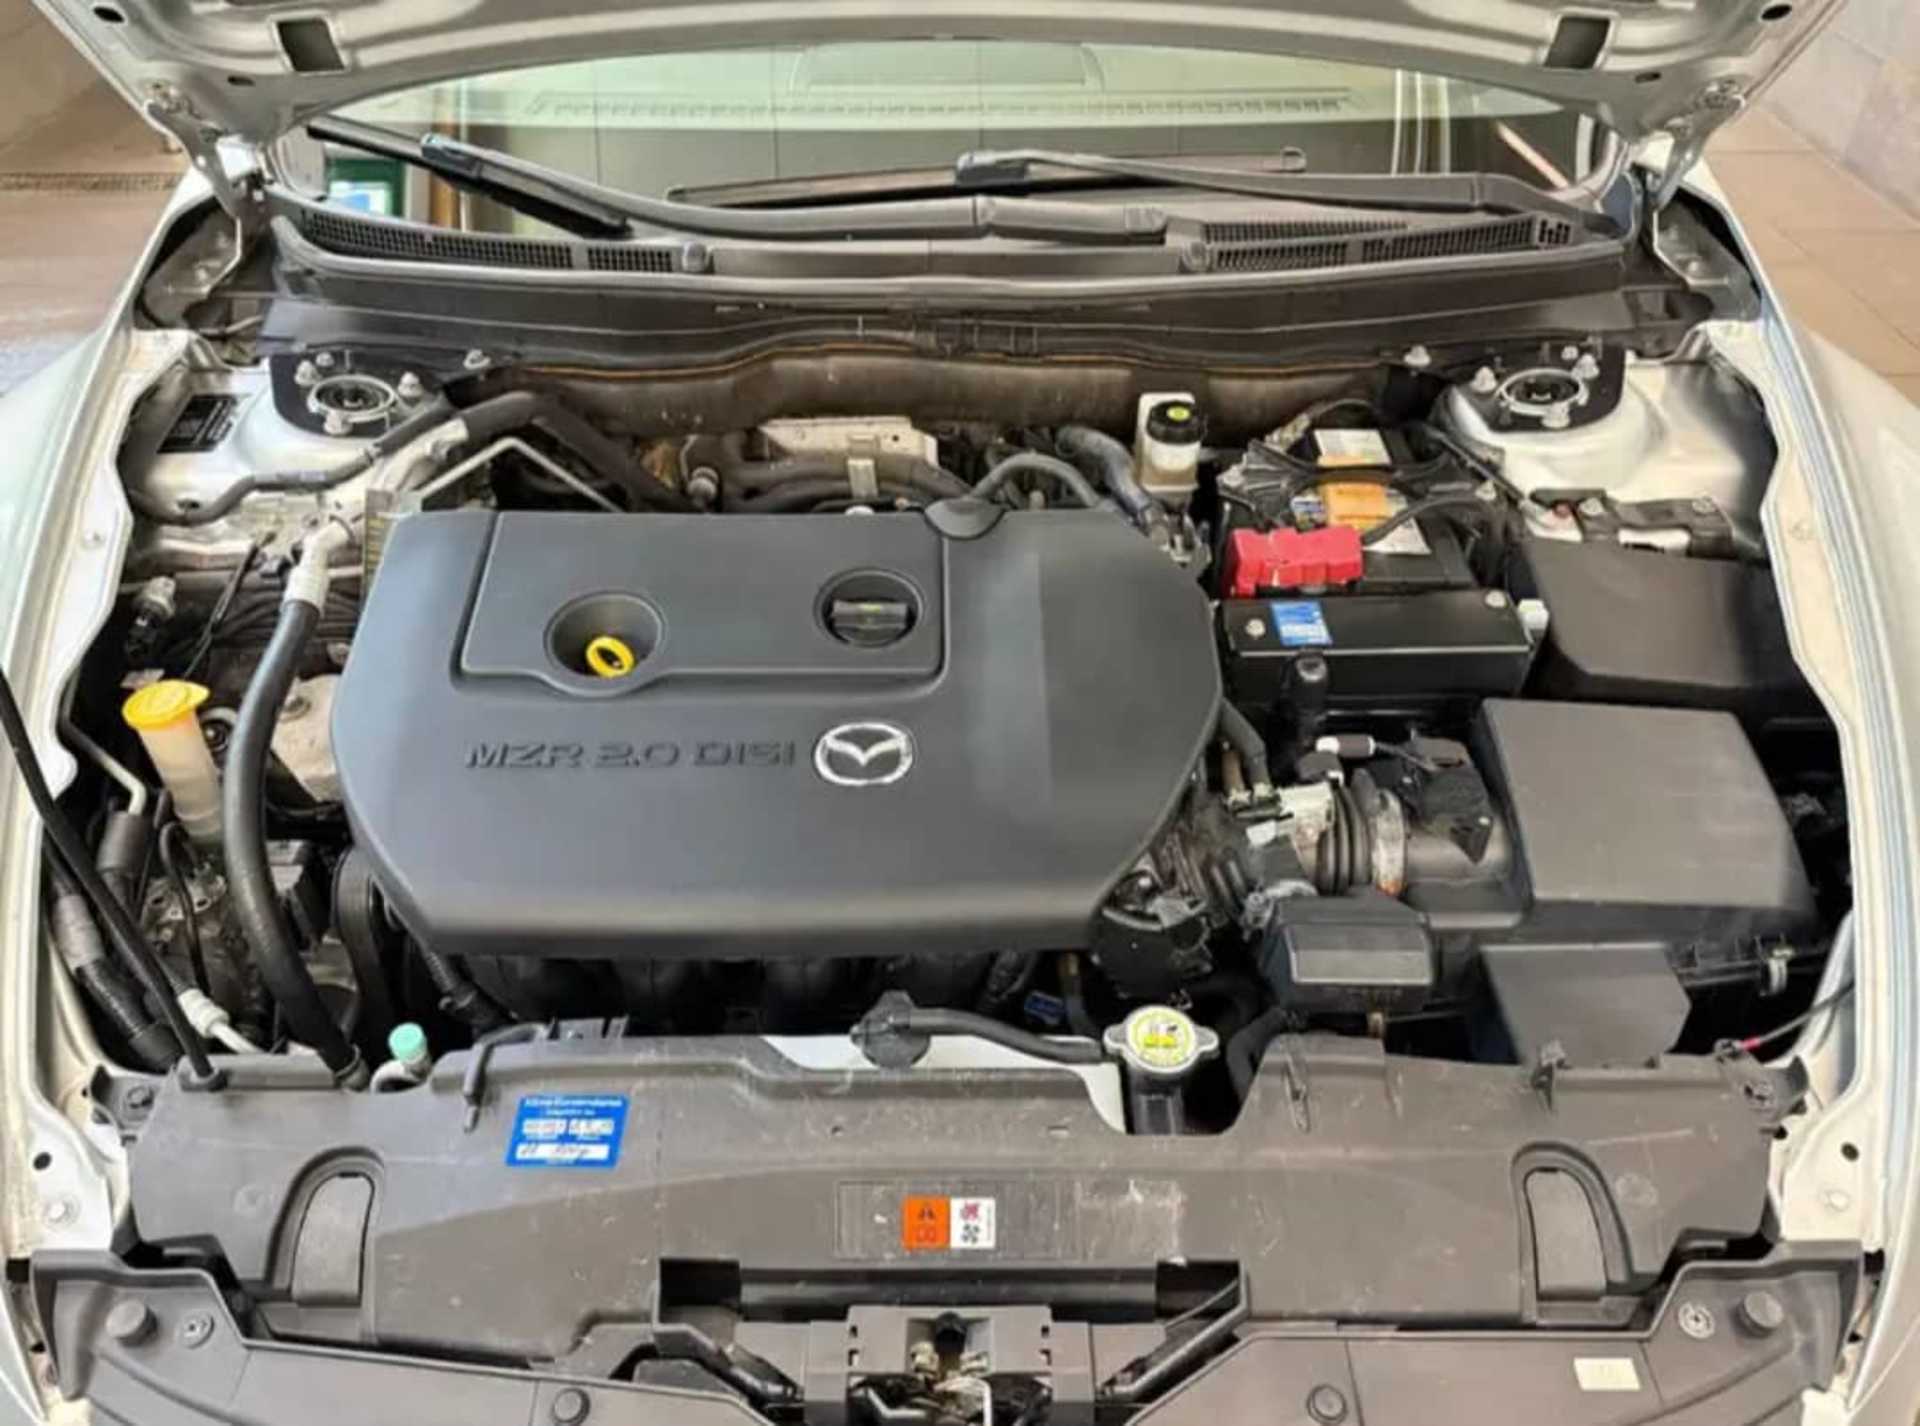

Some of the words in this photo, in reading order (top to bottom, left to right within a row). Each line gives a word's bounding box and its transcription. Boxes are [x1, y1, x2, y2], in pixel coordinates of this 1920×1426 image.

[466, 742, 585, 769] MZR
[596, 742, 680, 768] 2.0
[694, 741, 795, 768] DISI
